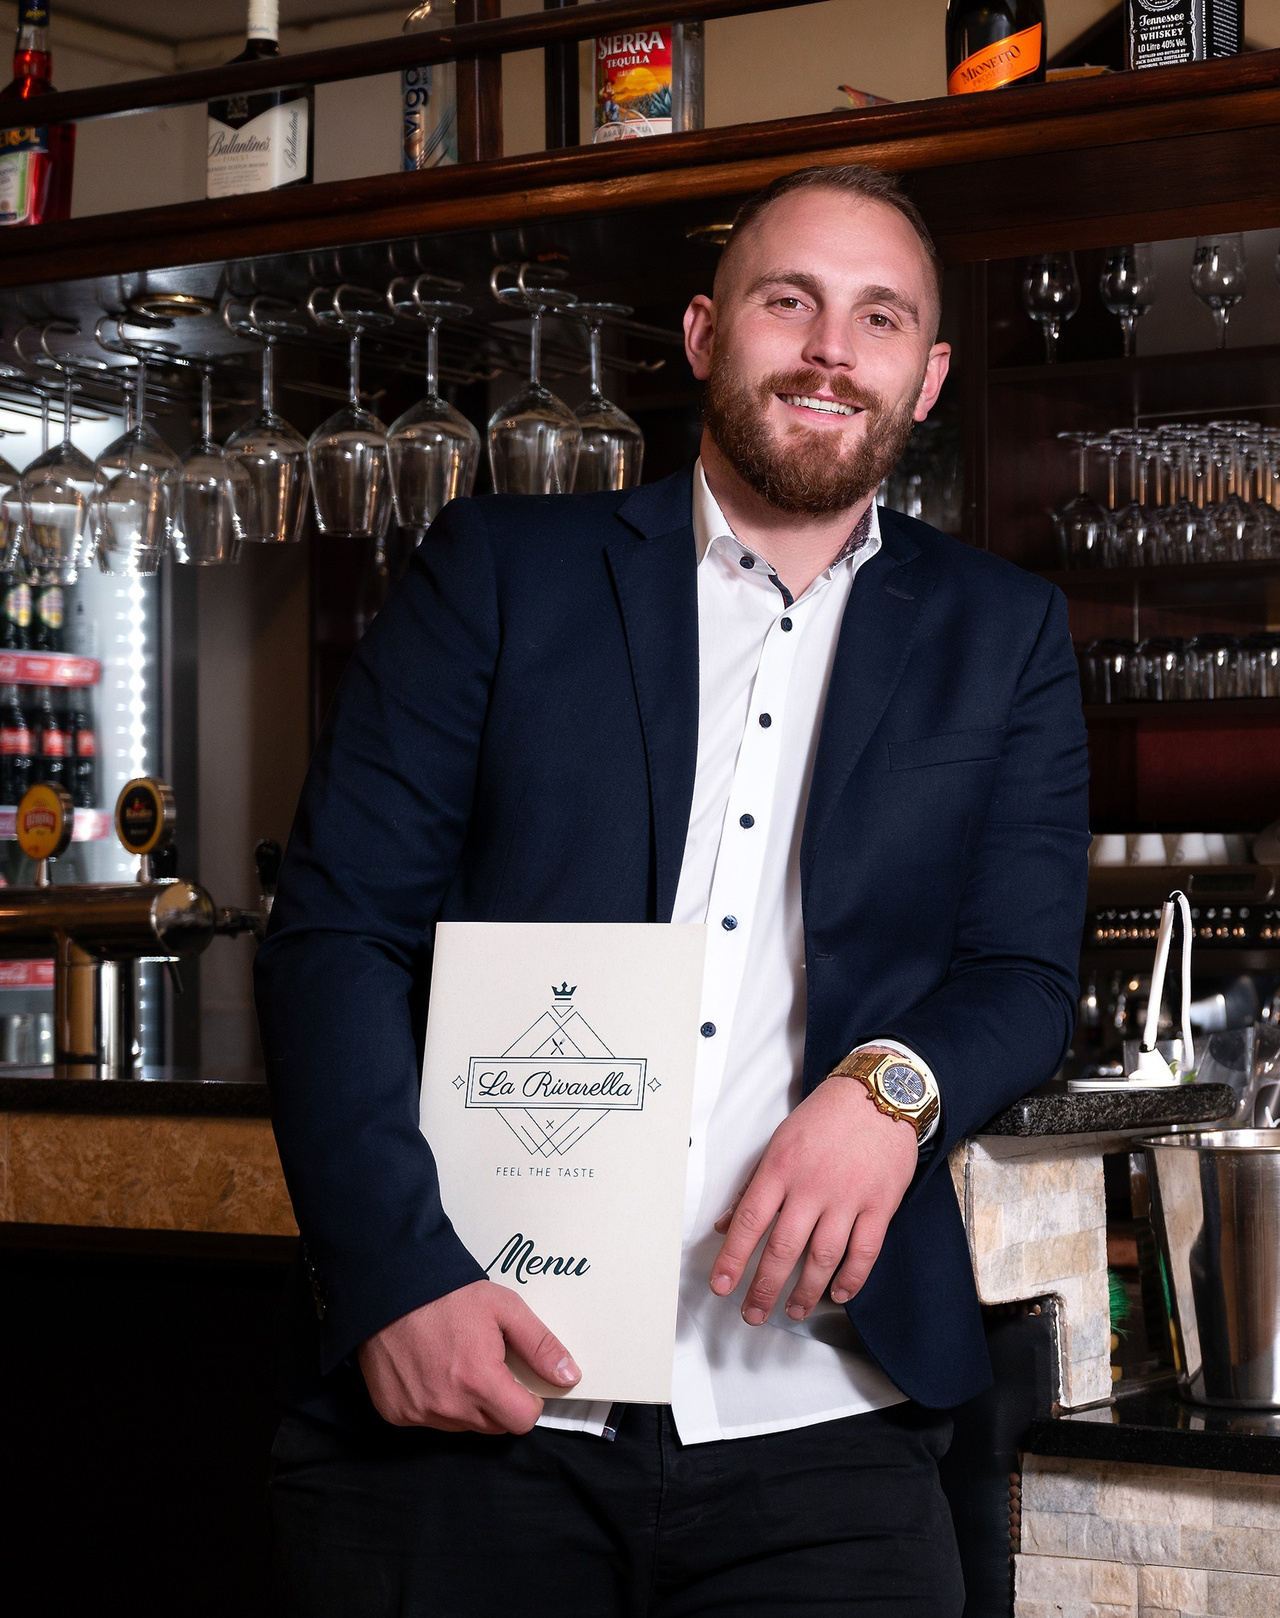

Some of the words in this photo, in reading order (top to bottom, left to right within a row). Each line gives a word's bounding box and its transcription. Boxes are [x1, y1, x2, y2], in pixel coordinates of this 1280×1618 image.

[1139, 13, 1185, 27] Tennessee
[1140, 28, 1184, 41] WHISKEY
[598, 31, 666, 60] SIERRA
[1147, 43, 1160, 52] Litre
[1161, 39, 1175, 49] 40%
[606, 54, 650, 69] TEQUILA
[208, 131, 271, 157] Ballantine's
[478, 1070, 515, 1097] La
[522, 1070, 633, 1098] Rivarella
[496, 1166, 522, 1177] FEEL
[529, 1167, 551, 1177] THE
[558, 1167, 595, 1178] TASTE
[485, 1232, 591, 1285] Menu
